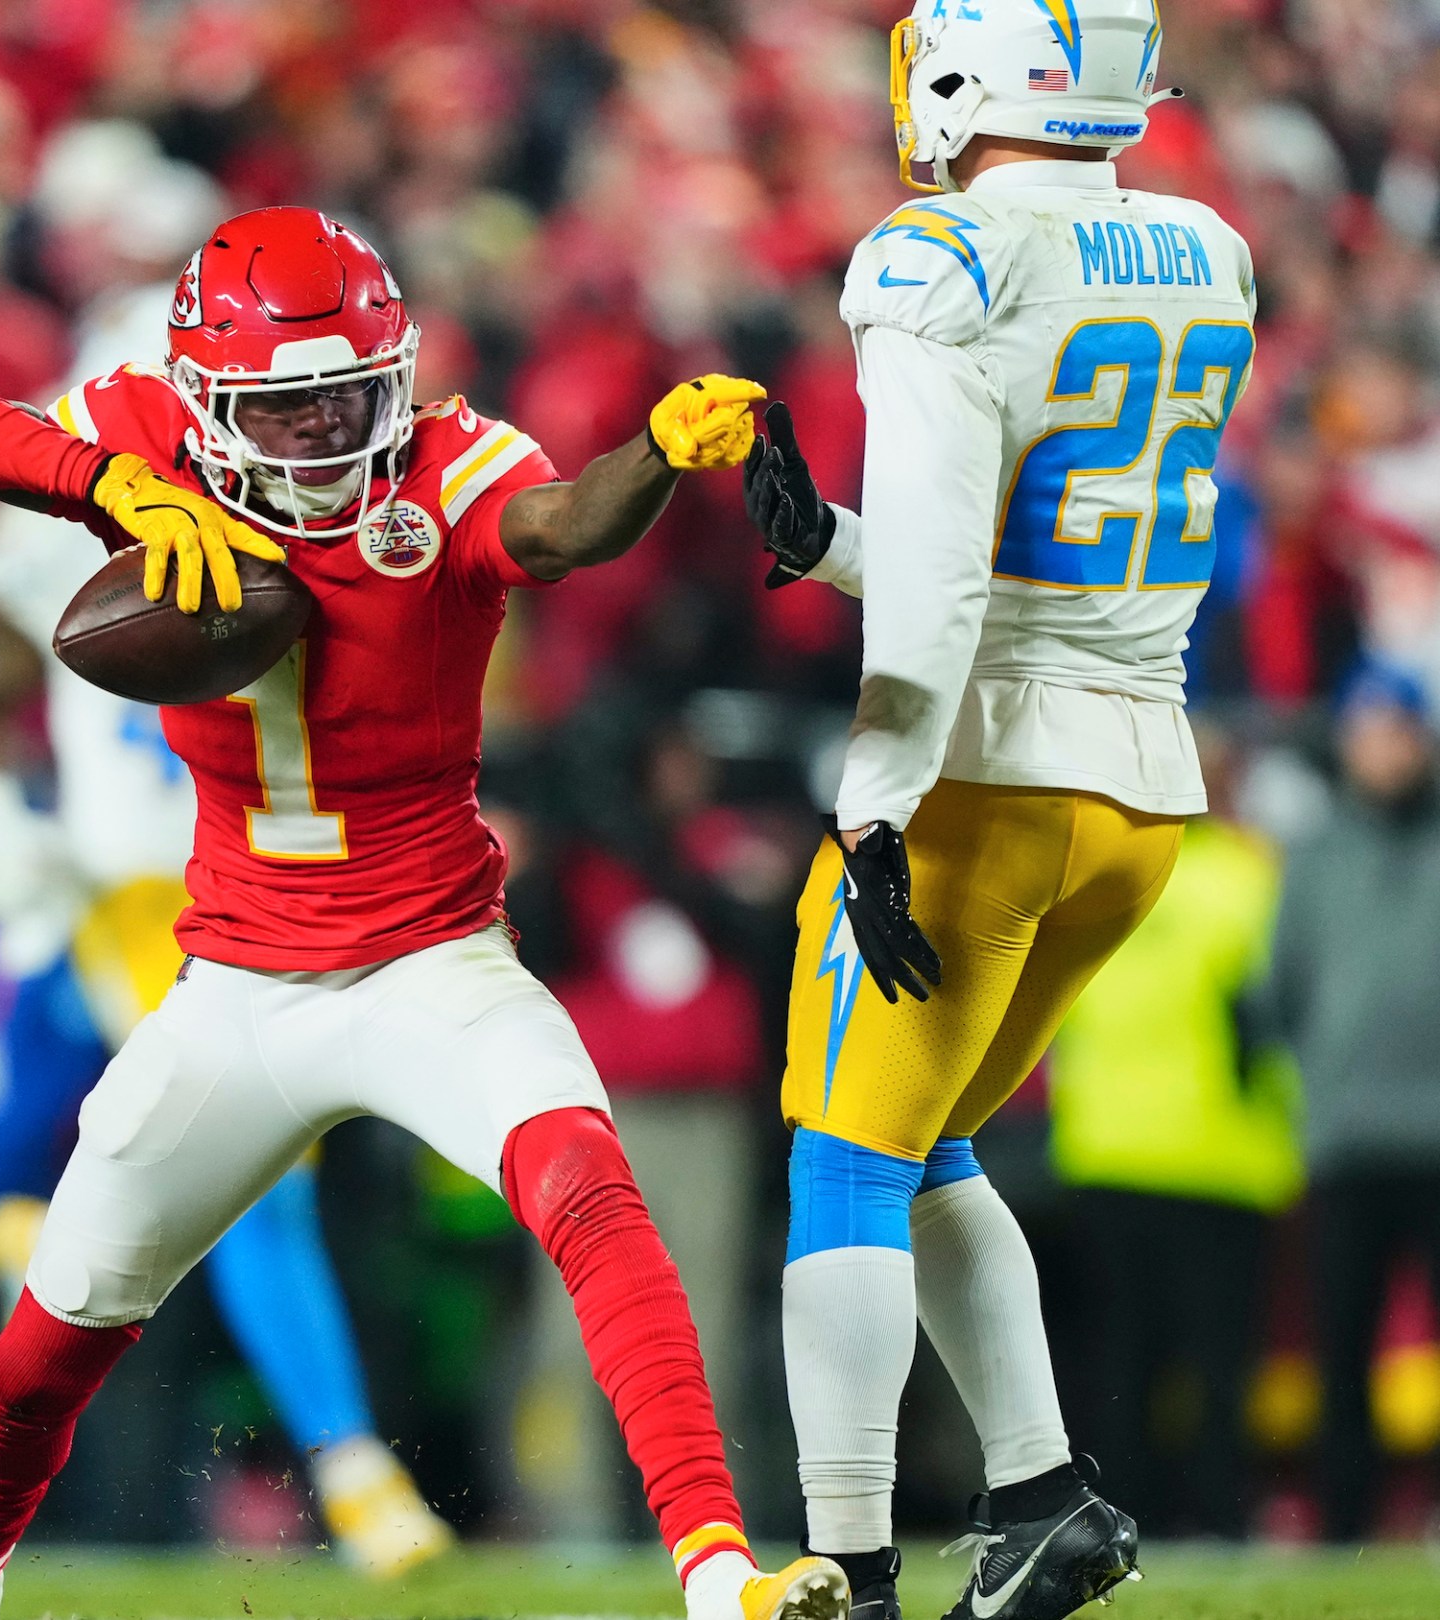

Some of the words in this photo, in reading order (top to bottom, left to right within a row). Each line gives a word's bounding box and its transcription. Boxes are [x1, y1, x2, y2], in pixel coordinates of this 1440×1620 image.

[1044, 120, 1143, 141] CHARGERS
[1073, 221, 1212, 286] MOLDEN
[991, 316, 1256, 592] 22
[210, 624, 229, 641] 315
[226, 638, 350, 861] 1
